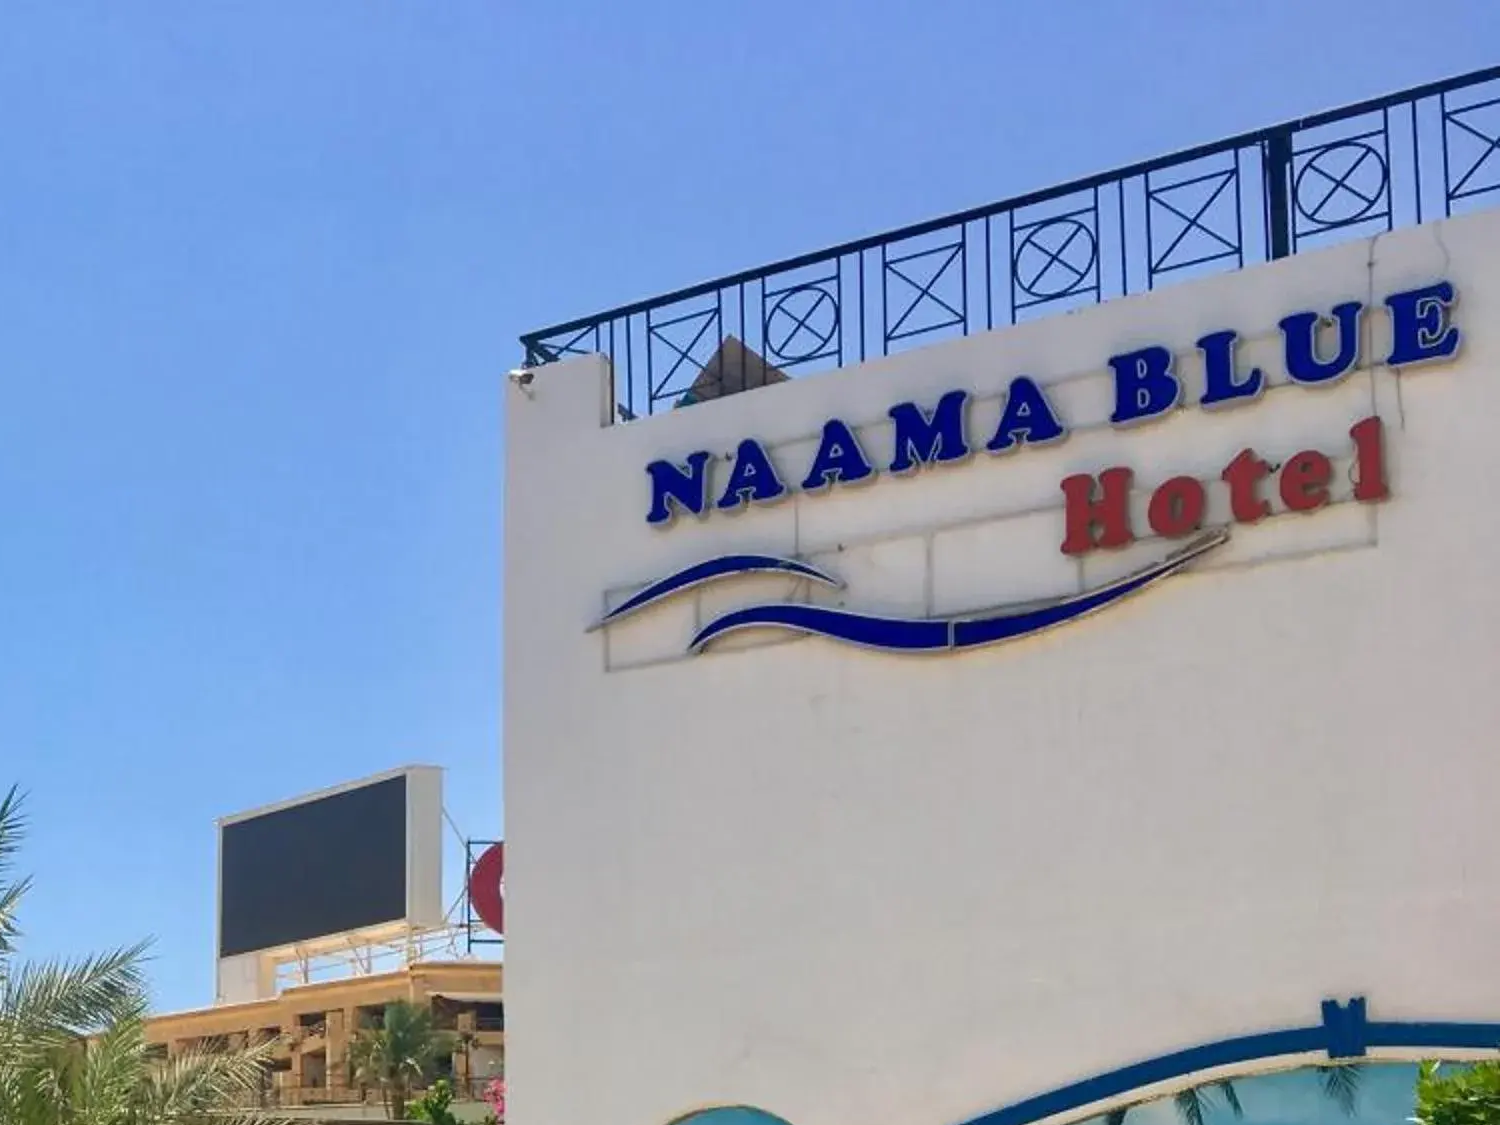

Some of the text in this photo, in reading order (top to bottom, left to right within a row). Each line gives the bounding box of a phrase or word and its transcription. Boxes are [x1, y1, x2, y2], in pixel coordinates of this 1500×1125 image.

[646, 281, 1461, 524] NAAMA BLUE
[1060, 417, 1389, 556] Hotel
